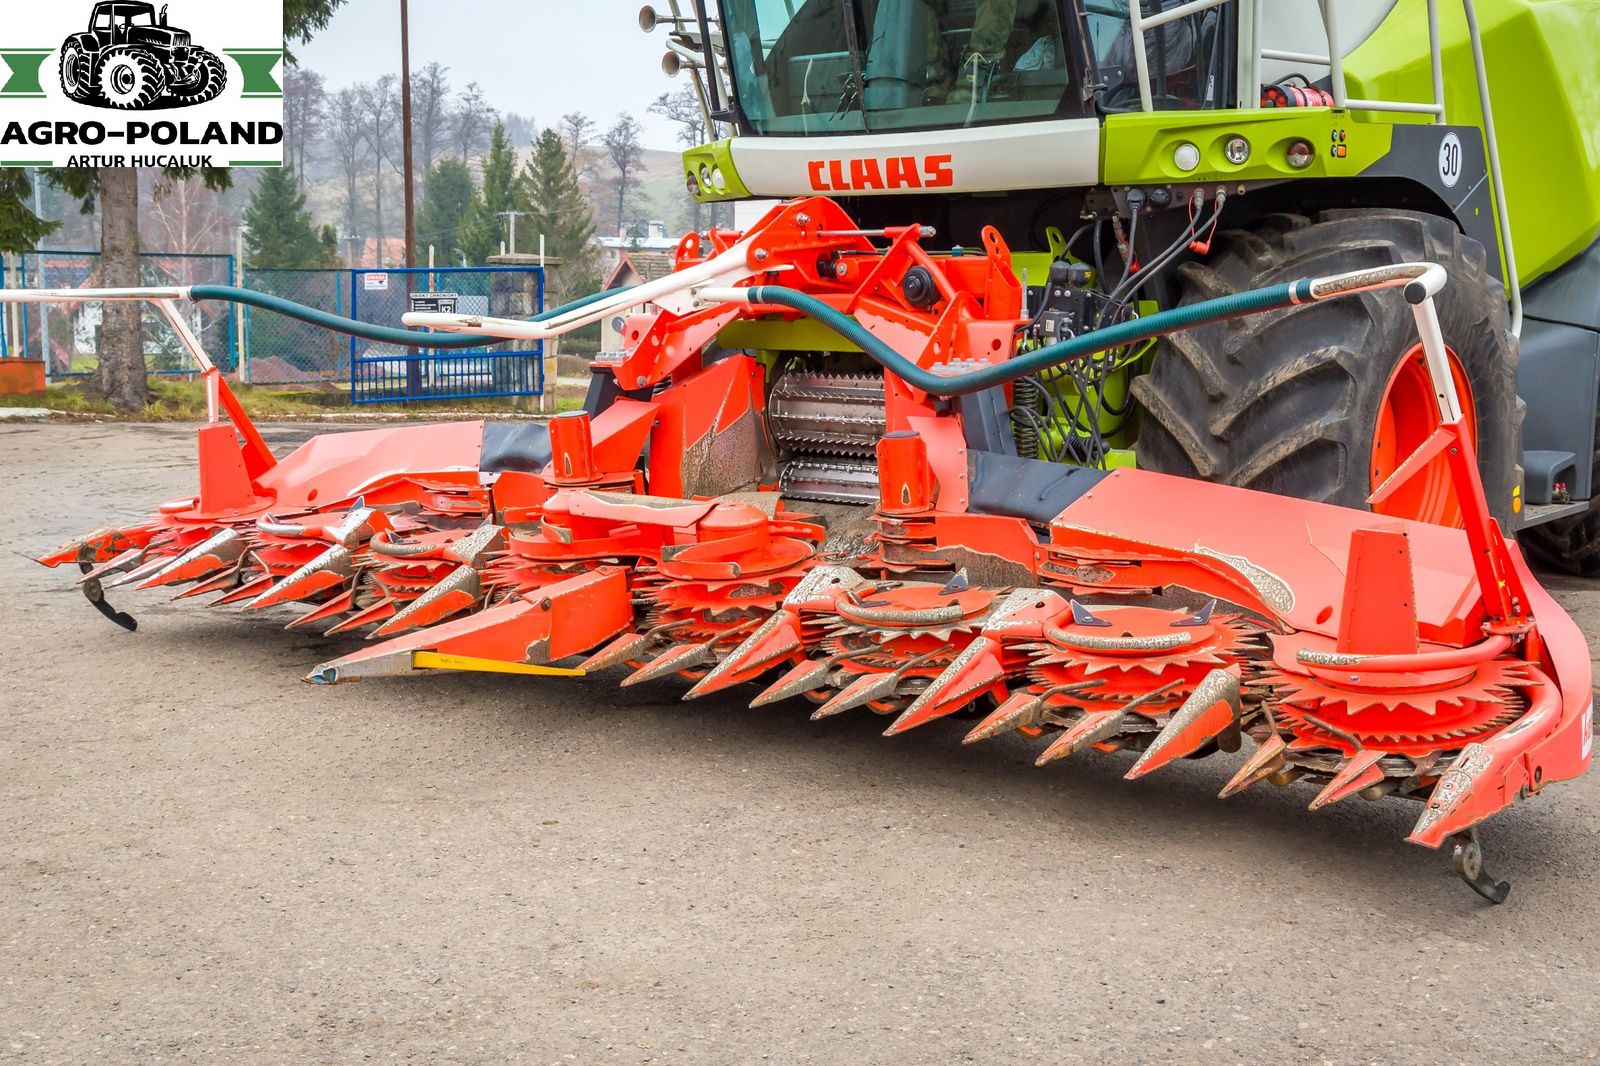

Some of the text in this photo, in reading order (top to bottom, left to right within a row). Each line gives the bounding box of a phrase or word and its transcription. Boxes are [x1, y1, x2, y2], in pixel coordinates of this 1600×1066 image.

[807, 154, 953, 191] CLAAS
[1442, 142, 1458, 177] 30
[441, 305, 451, 313] K2
